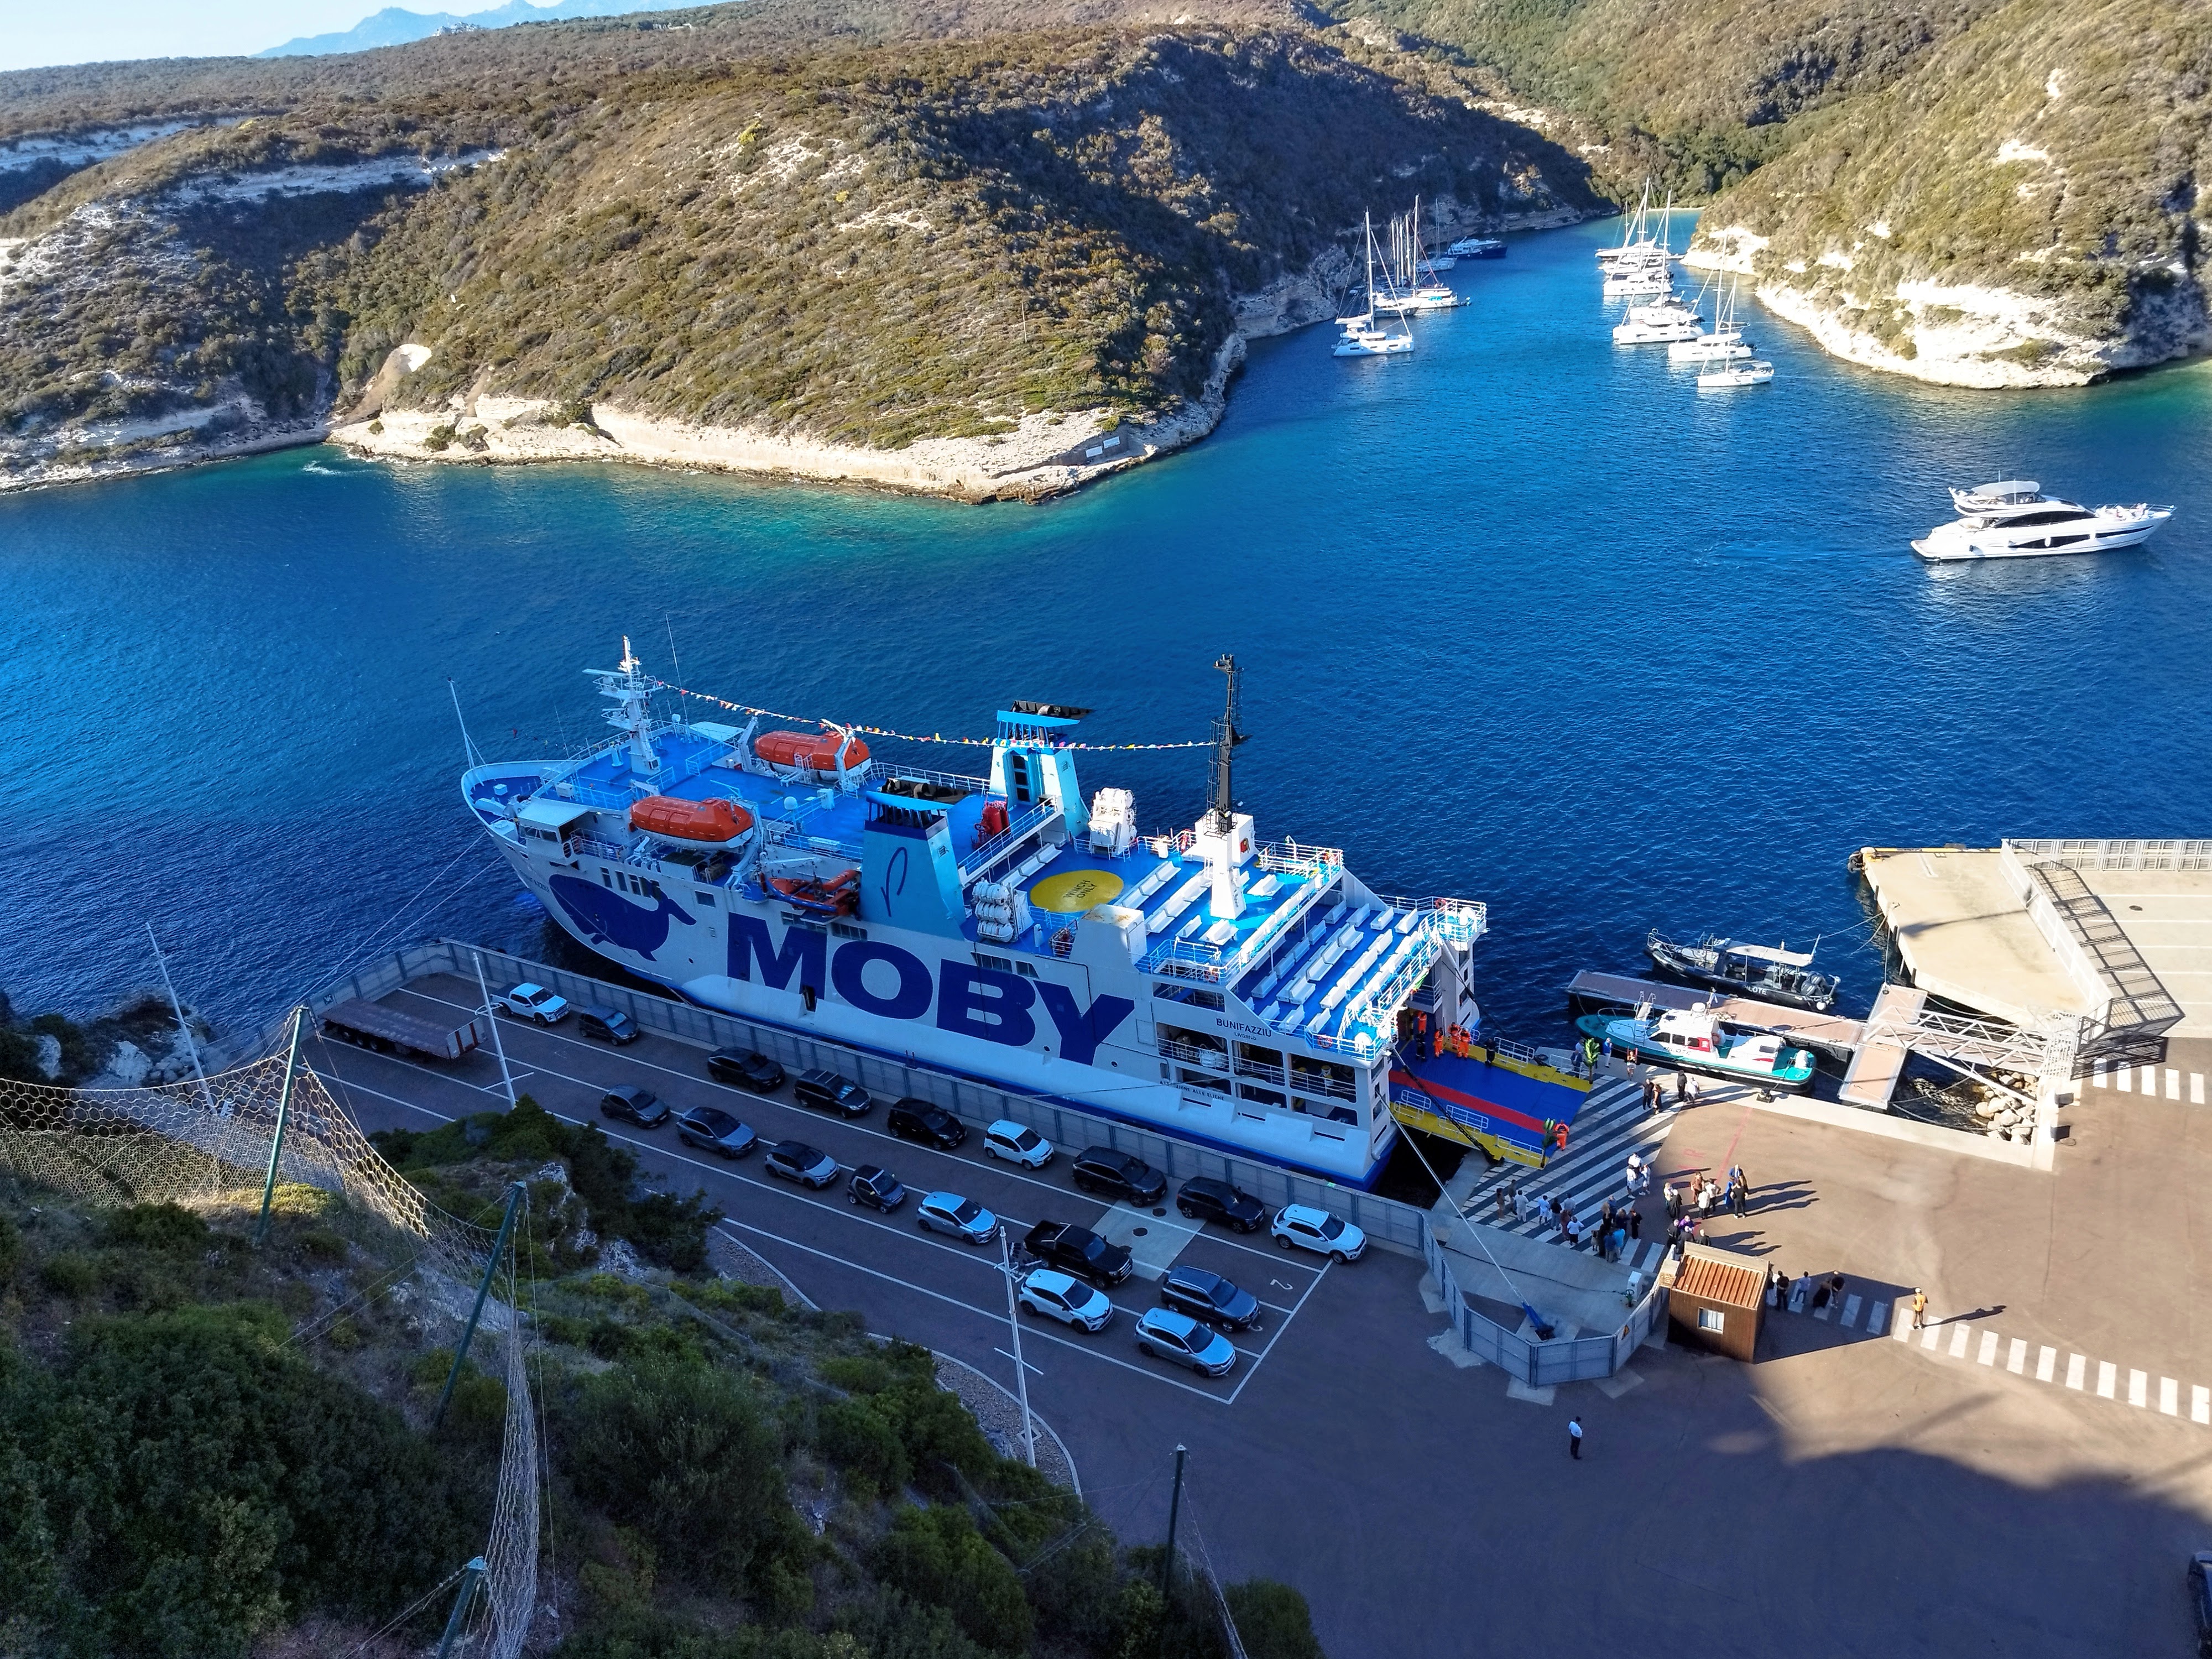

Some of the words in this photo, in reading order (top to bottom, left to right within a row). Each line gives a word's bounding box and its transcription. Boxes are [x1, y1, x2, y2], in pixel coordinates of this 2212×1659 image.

[1063, 880, 1091, 898] WINCH
[1076, 883, 1097, 898] ONLY
[727, 912, 1135, 1066] MOBY
[1216, 1018, 1271, 1037] BUNIFAZZIU
